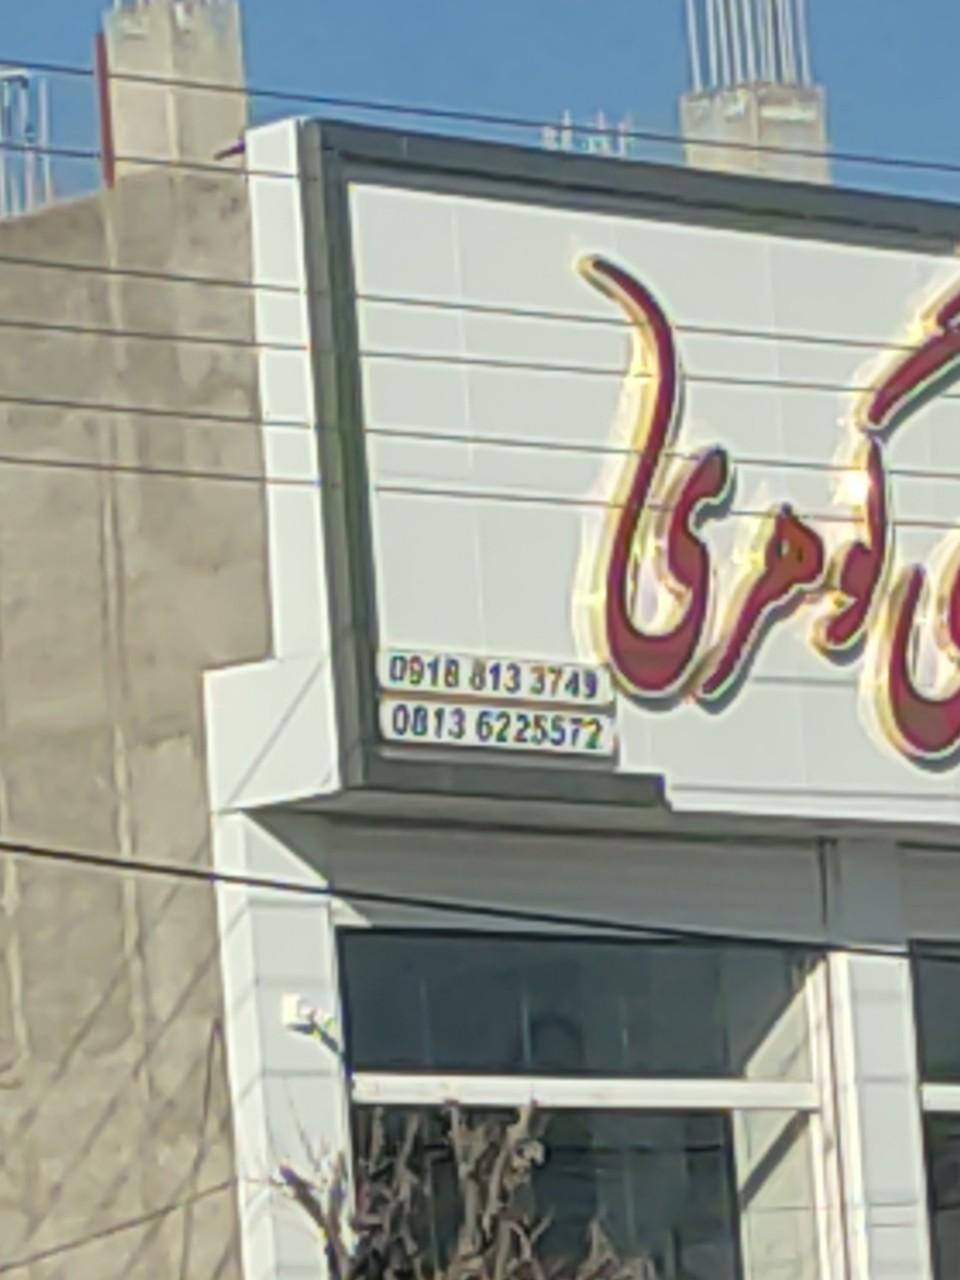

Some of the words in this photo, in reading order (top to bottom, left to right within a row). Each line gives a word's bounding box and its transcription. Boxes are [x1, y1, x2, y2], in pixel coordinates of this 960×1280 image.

[390, 654, 460, 688] 0918
[529, 664, 599, 699] 3749
[391, 702, 466, 740] 0813
[475, 709, 603, 750] 6225572
